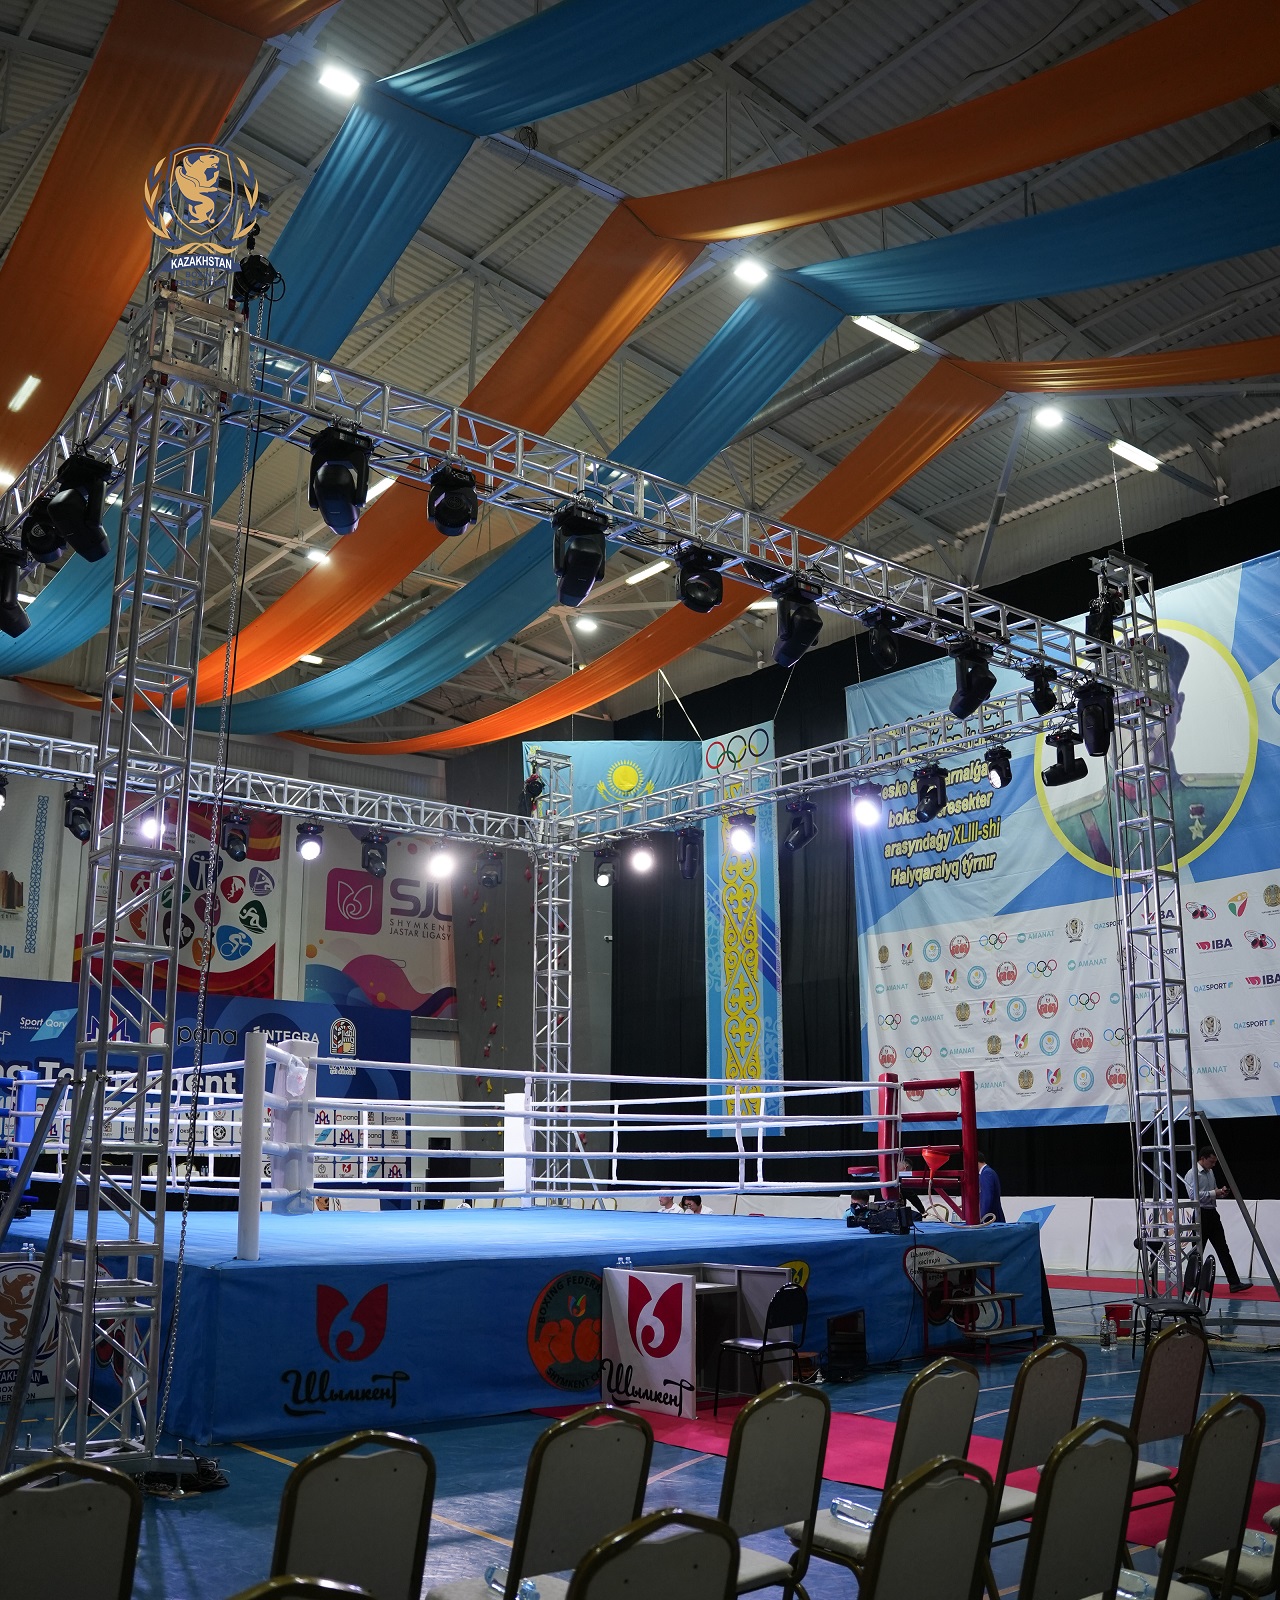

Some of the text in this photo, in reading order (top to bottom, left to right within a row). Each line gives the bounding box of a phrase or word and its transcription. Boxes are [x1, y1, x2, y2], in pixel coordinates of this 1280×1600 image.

[881, 780, 909, 800] eske
[952, 816, 1001, 846] XLIII-shi
[890, 858, 960, 888] Halyqaralyq
[389, 918, 452, 932] SHYMKENT
[389, 927, 452, 941] JASTAR LIGASY
[1027, 929, 1056, 941] AMANAT
[1211, 938, 1233, 950] IBA
[1077, 957, 1108, 968] AMANAT
[1262, 973, 1280, 985] IBA
[885, 983, 909, 992] AMANAT
[1193, 981, 1227, 993] QAZSPORT
[20, 1016, 67, 1030] Sport Qory
[920, 1014, 945, 1023] AMANAT
[1233, 1019, 1269, 1030] QAZSPORT
[949, 1046, 976, 1056] AMANAT
[1196, 1065, 1228, 1076] AMANAT
[979, 1080, 1007, 1090] AMANAT
[538, 1275, 602, 1324] BOXING FEDERA
[546, 1367, 590, 1389] SHYMKENT
[281, 1369, 410, 1417] Шымкент
[602, 1358, 695, 1417] Шымкент
